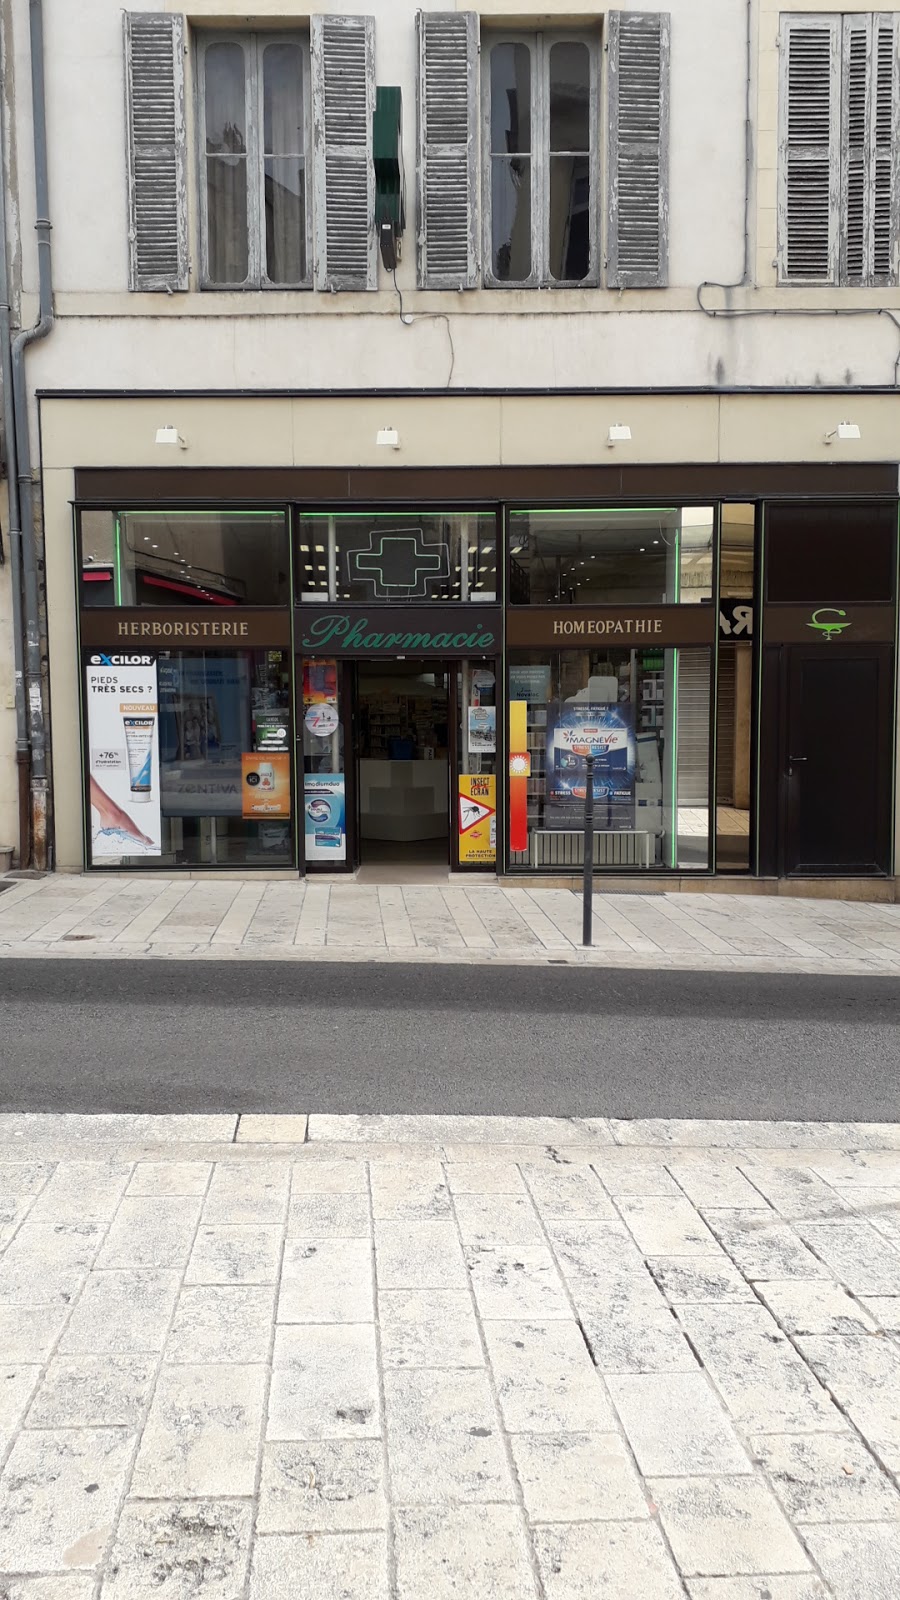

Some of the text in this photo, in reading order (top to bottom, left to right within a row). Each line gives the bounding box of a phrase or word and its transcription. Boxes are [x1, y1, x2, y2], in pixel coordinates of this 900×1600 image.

[117, 622, 249, 636] HERBORISTERIE
[302, 614, 495, 649] Pharmacie
[553, 619, 663, 634] HOMEOPATHIE
[91, 676, 118, 684] PIEDS
[91, 684, 117, 693] TRÈS
[119, 685, 144, 693] SECS
[147, 685, 153, 693] ?
[470, 777, 490, 786] INSECT
